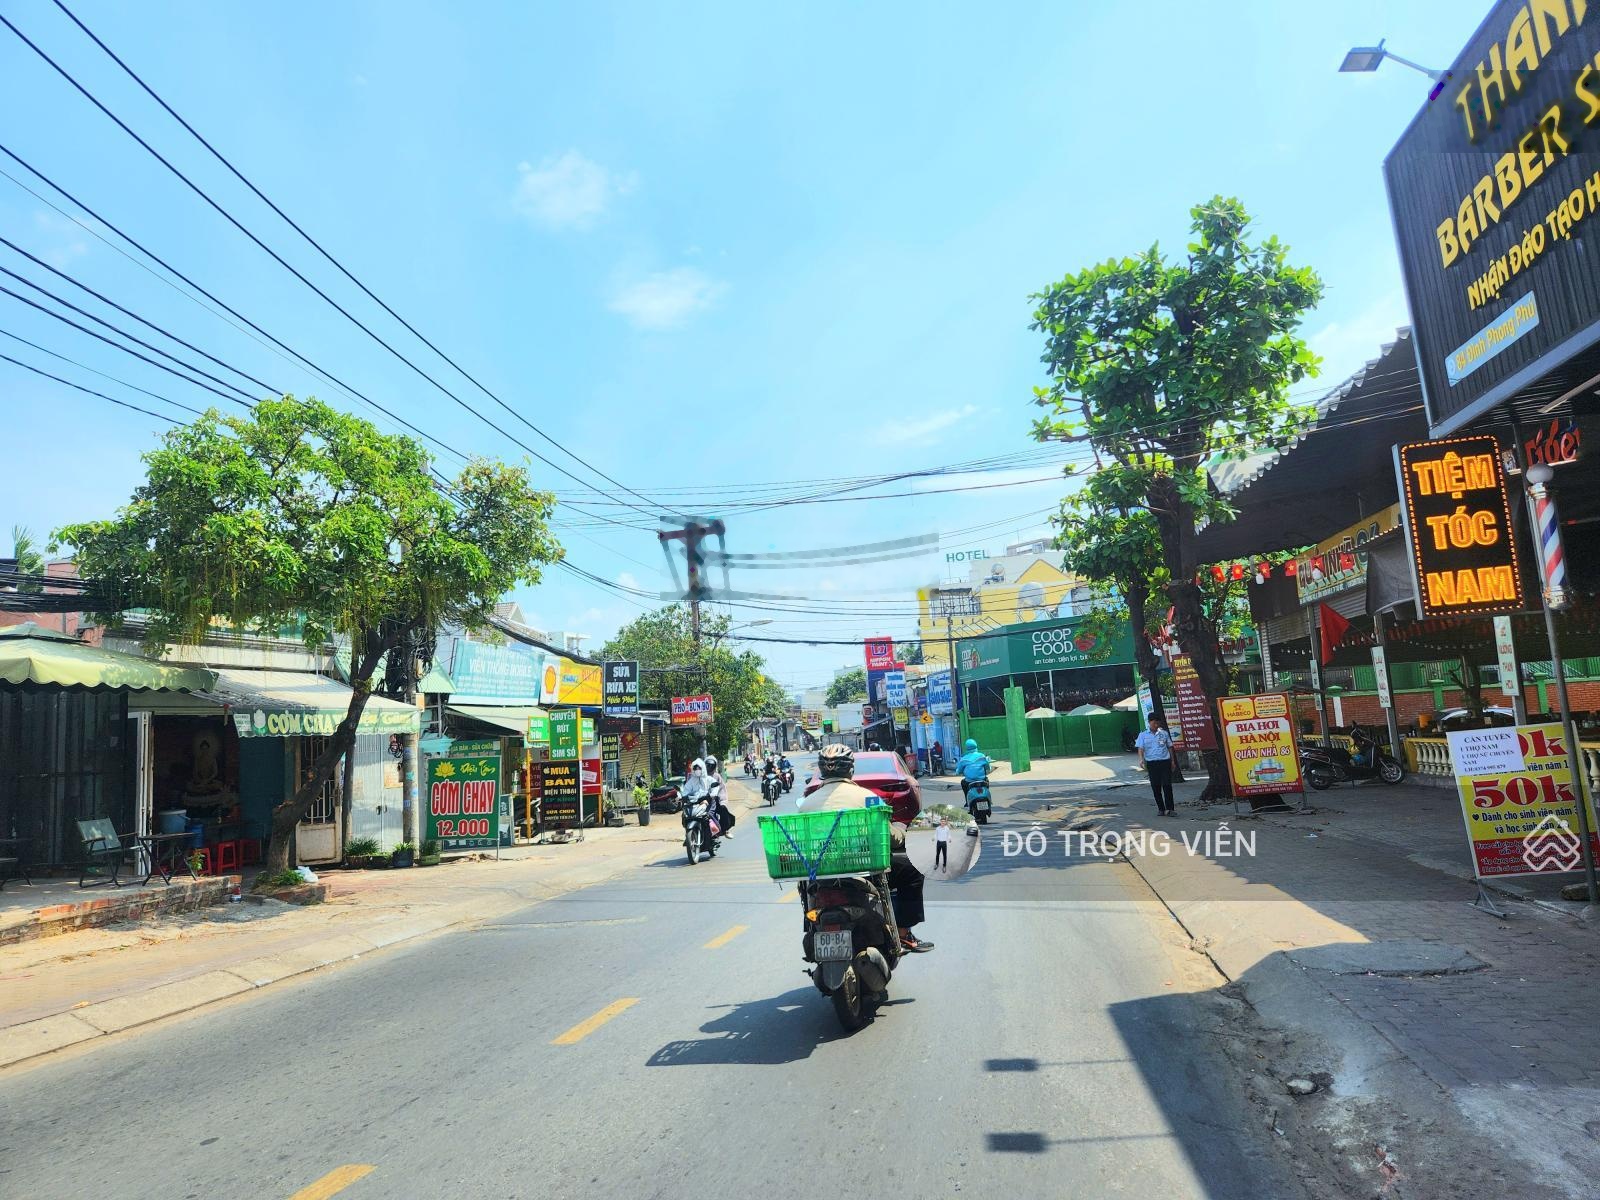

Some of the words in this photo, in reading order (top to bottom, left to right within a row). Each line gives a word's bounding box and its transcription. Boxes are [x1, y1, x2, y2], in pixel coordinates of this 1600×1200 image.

[1436, 104, 1568, 269] BARBER
[1467, 255, 1510, 311] NHẬN
[1508, 223, 1545, 275] ĐÀO
[1545, 188, 1585, 240] TẠO
[1412, 451, 1496, 499] TIỆM
[1426, 505, 1498, 550] TÓC
[946, 549, 990, 563] HOTEL
[1426, 565, 1516, 607] NAM
[1032, 640, 1073, 657] FOOD
[613, 663, 630, 678] SỬA
[607, 679, 623, 693] RỬA
[625, 681, 636, 693] XE
[267, 710, 300, 734] CƠM
[556, 723, 569, 733] RÚT
[1235, 722, 1255, 732] BIA
[1257, 720, 1280, 730] HƠI
[1238, 732, 1257, 744] HÀ
[1258, 731, 1280, 743] NỘI
[552, 749, 565, 758] SIM
[1234, 745, 1258, 761] QUÁN
[1260, 744, 1278, 757] NHÀ
[1280, 745, 1291, 756] 86
[551, 767, 570, 775] MUA
[1527, 761, 1544, 772] viên
[1545, 759, 1563, 770] năm
[545, 778, 575, 786] BÁN
[431, 778, 461, 816] CƠM
[462, 780, 495, 815] CHAY
[1472, 775, 1575, 809] 50k
[1504, 811, 1517, 820] cho
[1519, 809, 1536, 818] sinh
[436, 818, 489, 837] 12.000
[1494, 825, 1504, 833] và
[1505, 824, 1520, 834] học
